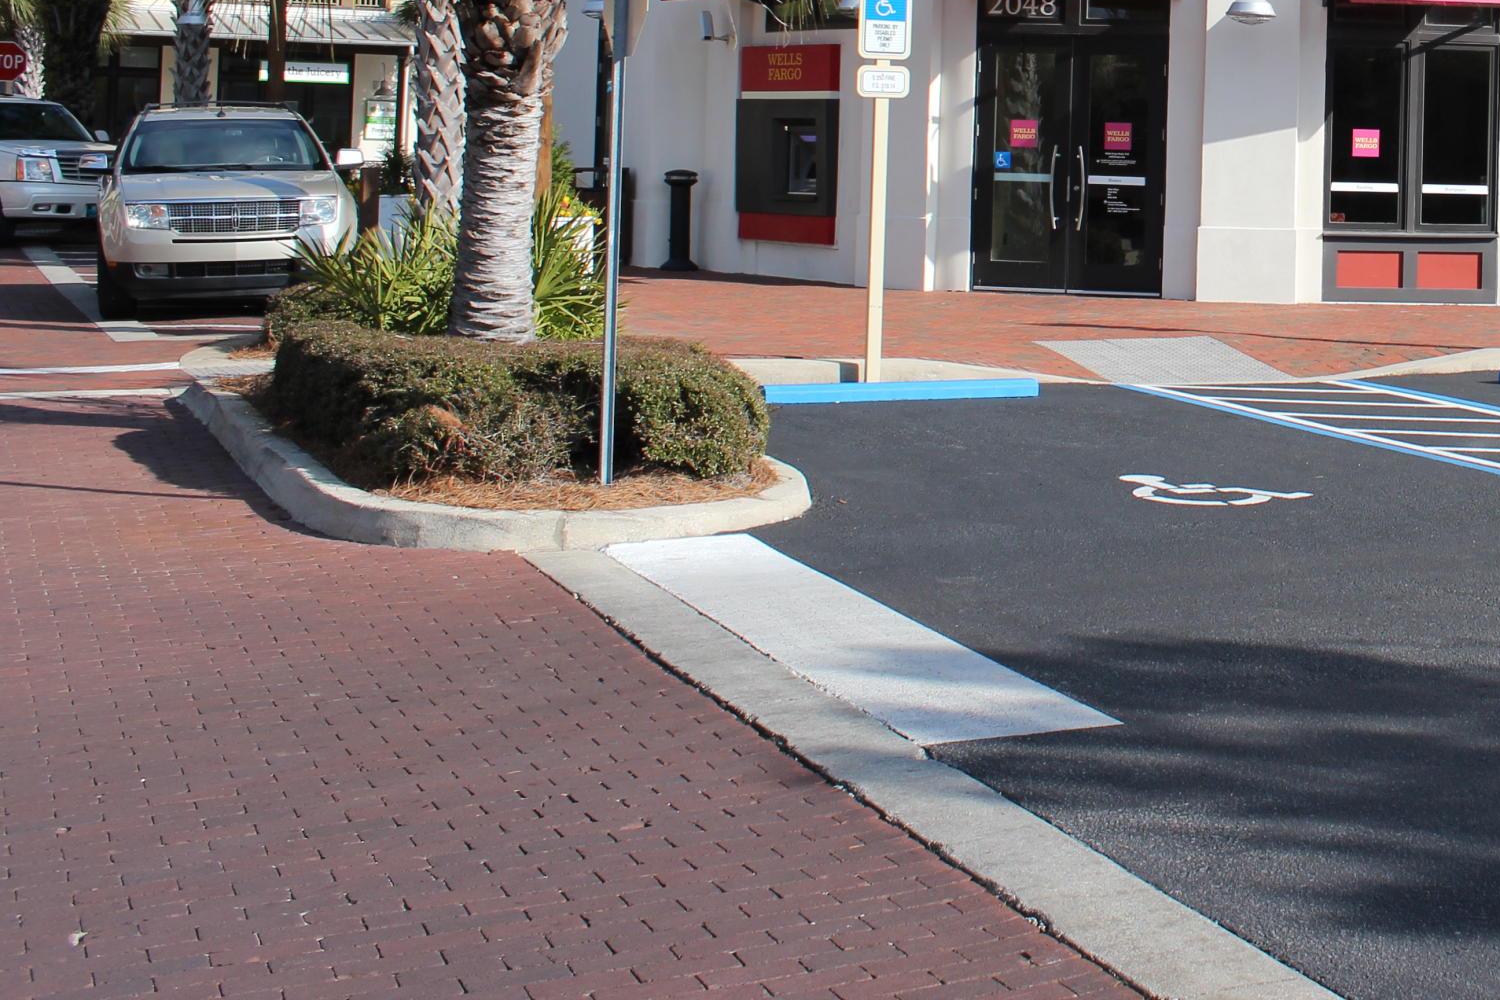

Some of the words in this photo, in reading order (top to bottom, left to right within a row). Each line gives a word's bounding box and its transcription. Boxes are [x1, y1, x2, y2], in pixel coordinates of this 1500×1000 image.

[0, 54, 25, 69] OP
[767, 53, 803, 66] WELLS
[287, 66, 304, 76] the
[306, 66, 342, 79] Juicery
[767, 67, 802, 81] FARGO
